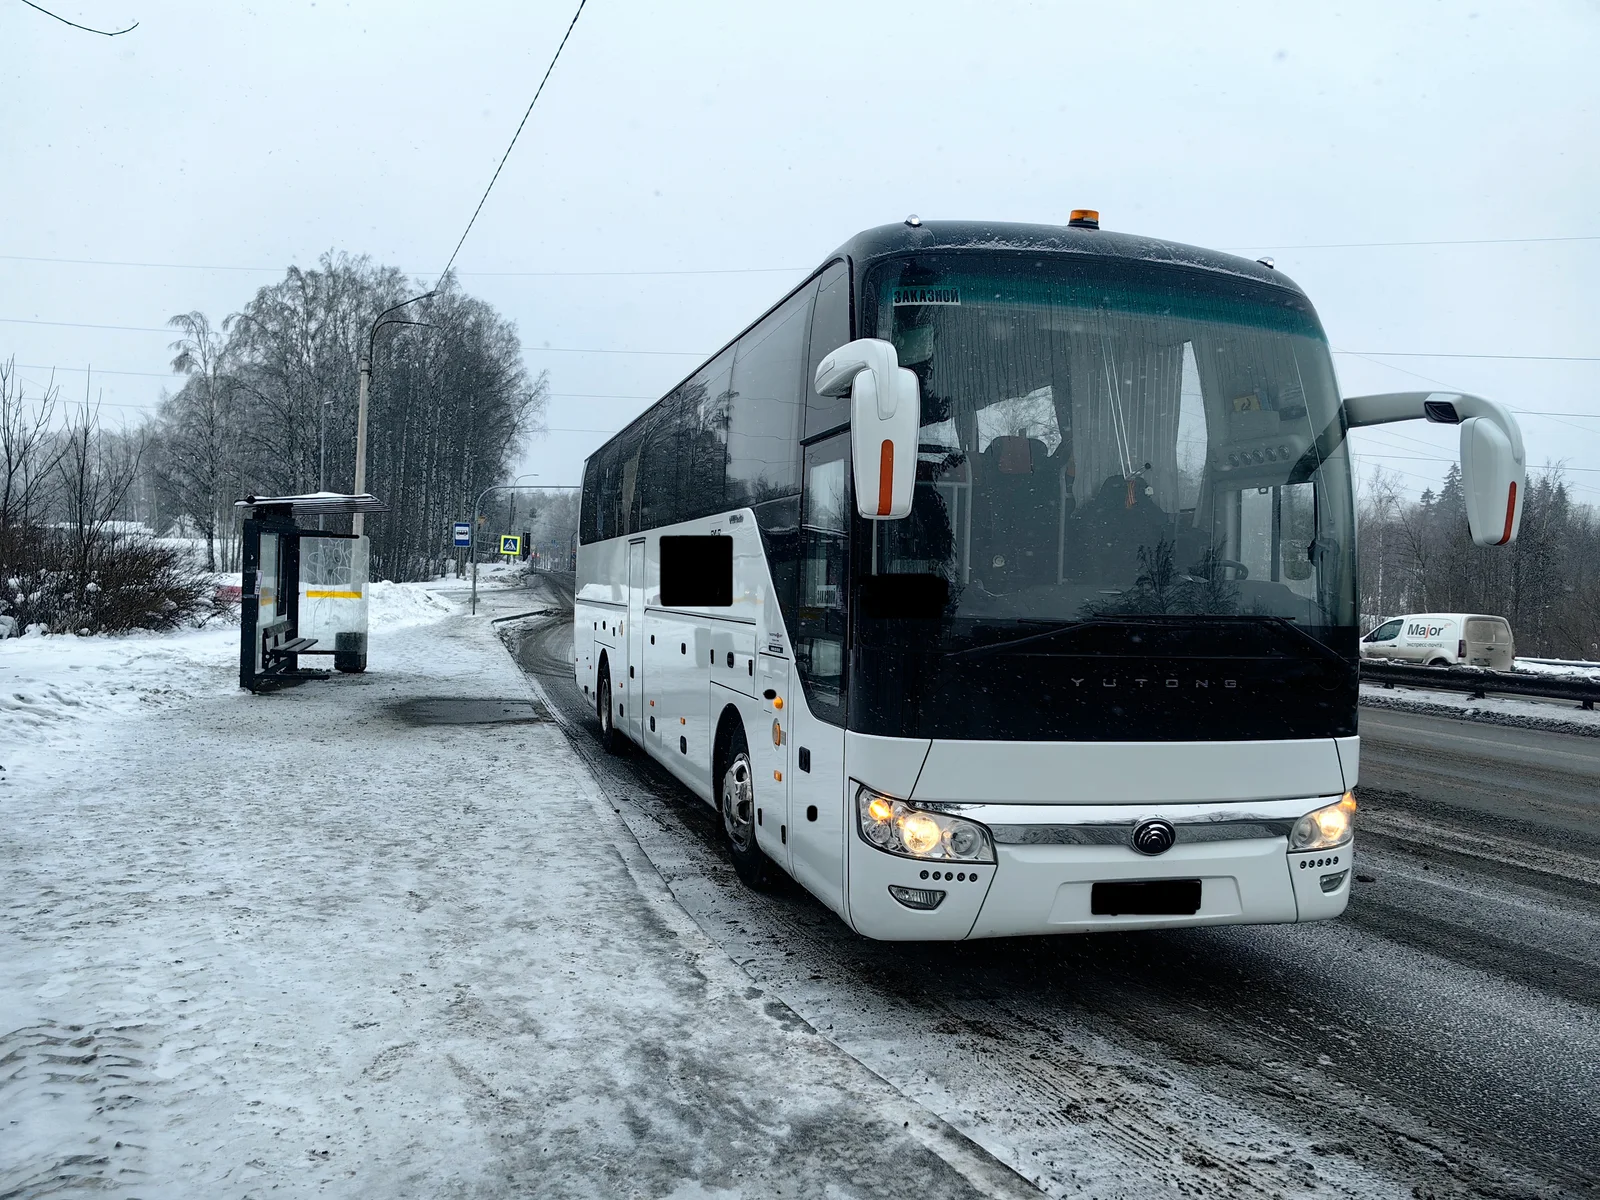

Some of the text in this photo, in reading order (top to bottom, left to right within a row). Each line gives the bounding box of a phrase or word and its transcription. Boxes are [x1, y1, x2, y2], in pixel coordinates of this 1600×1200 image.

[893, 287, 959, 303] ЗАКАЗНОЙ
[1407, 624, 1444, 638] Major
[1071, 678, 1237, 688] YUTONG
